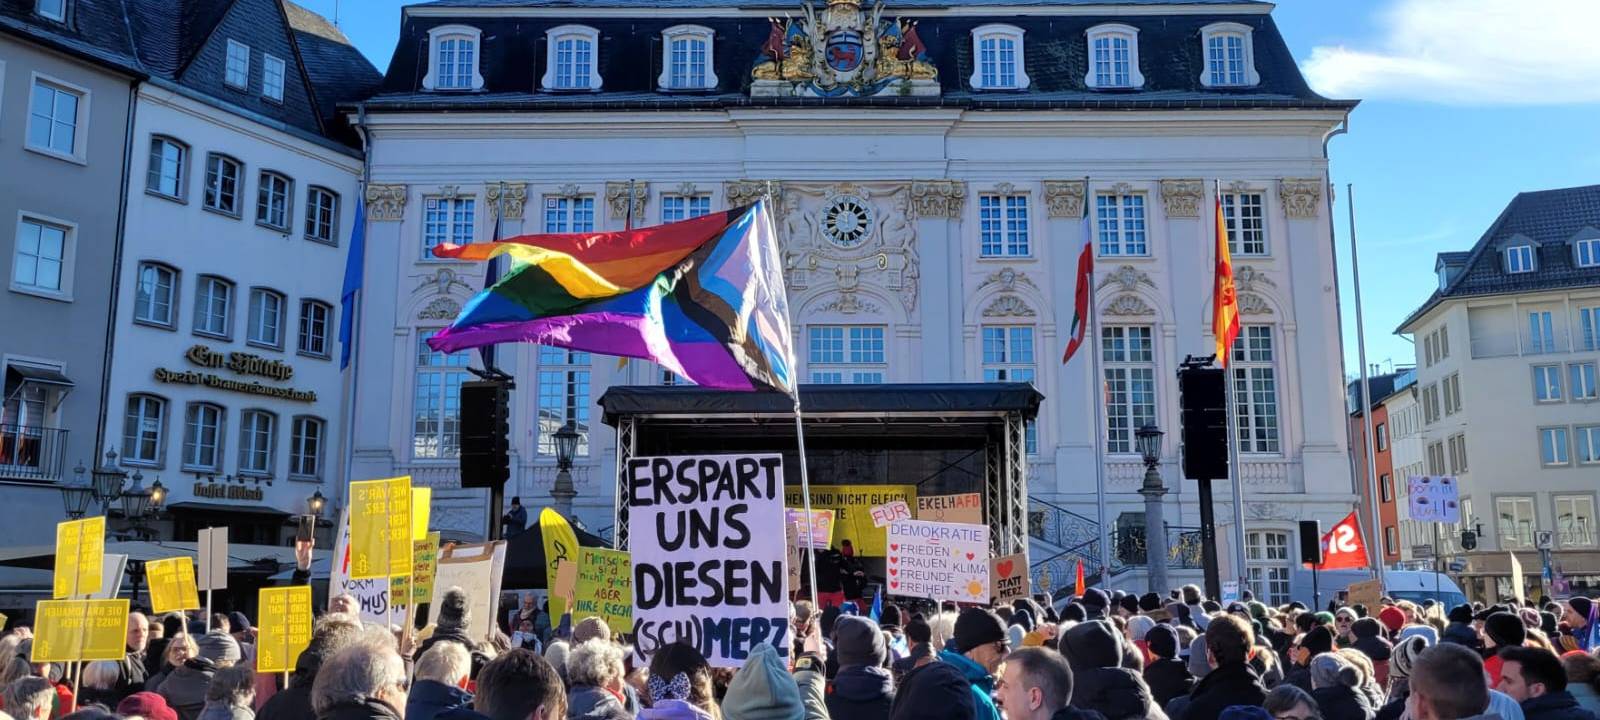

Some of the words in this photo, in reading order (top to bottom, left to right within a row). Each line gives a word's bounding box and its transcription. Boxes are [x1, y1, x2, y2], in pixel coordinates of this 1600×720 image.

[628, 457, 781, 506] ERSPART
[811, 493, 834, 506] SIND
[837, 493, 868, 506] NICHT
[918, 494, 979, 510] EKELHAFD
[656, 503, 751, 551] UNS
[891, 523, 983, 542] DEMOKRATIE
[900, 544, 950, 557] FRIEDEN
[900, 556, 947, 569] FRAUEN
[953, 563, 988, 575] KLIMA
[900, 569, 955, 583] FREUNDE
[998, 575, 1022, 589] STATT
[635, 559, 782, 610] DIESEN
[900, 582, 950, 595] FREIHEIT
[594, 588, 621, 602] ABER
[999, 586, 1023, 598] MERZ
[576, 599, 599, 612] IHRE
[603, 602, 632, 618] RECHT
[632, 614, 789, 662] (SCH)MERZ
